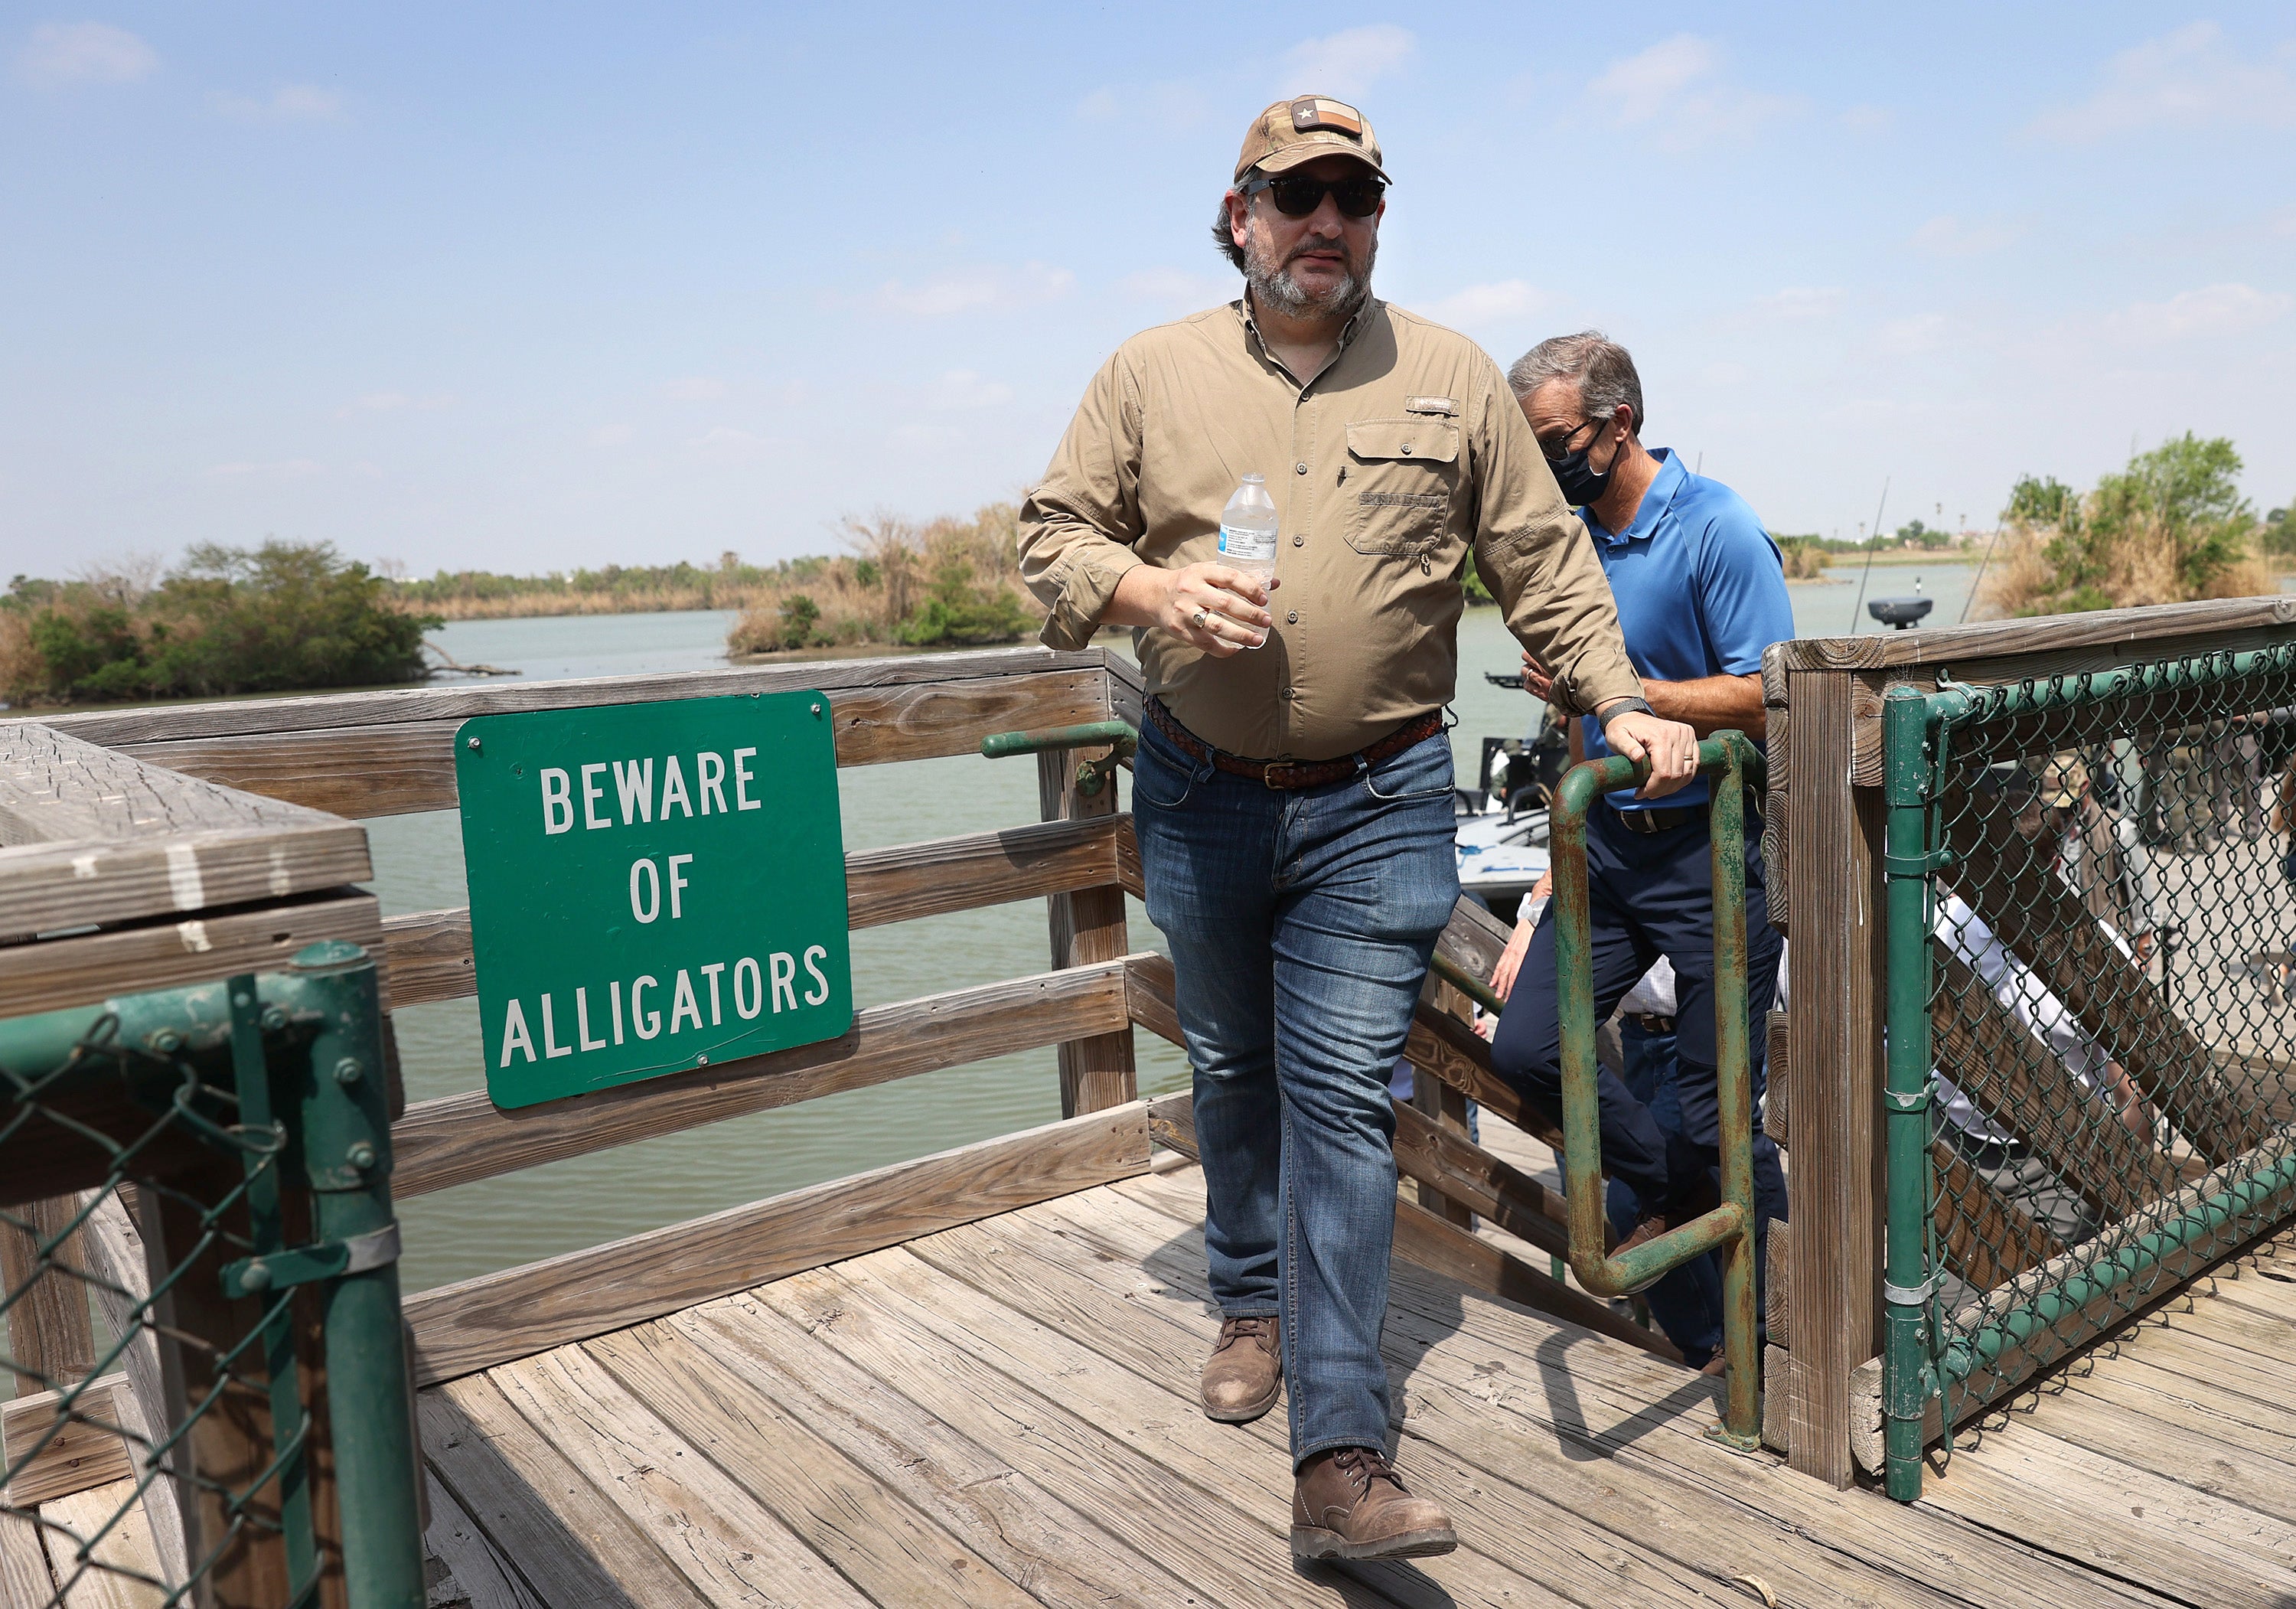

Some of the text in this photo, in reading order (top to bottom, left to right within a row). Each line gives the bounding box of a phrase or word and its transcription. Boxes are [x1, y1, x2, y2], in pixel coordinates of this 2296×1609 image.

[540, 746, 762, 835] BEWARE
[630, 853, 693, 924] OF
[500, 945, 829, 1068] ALLIGATORS
